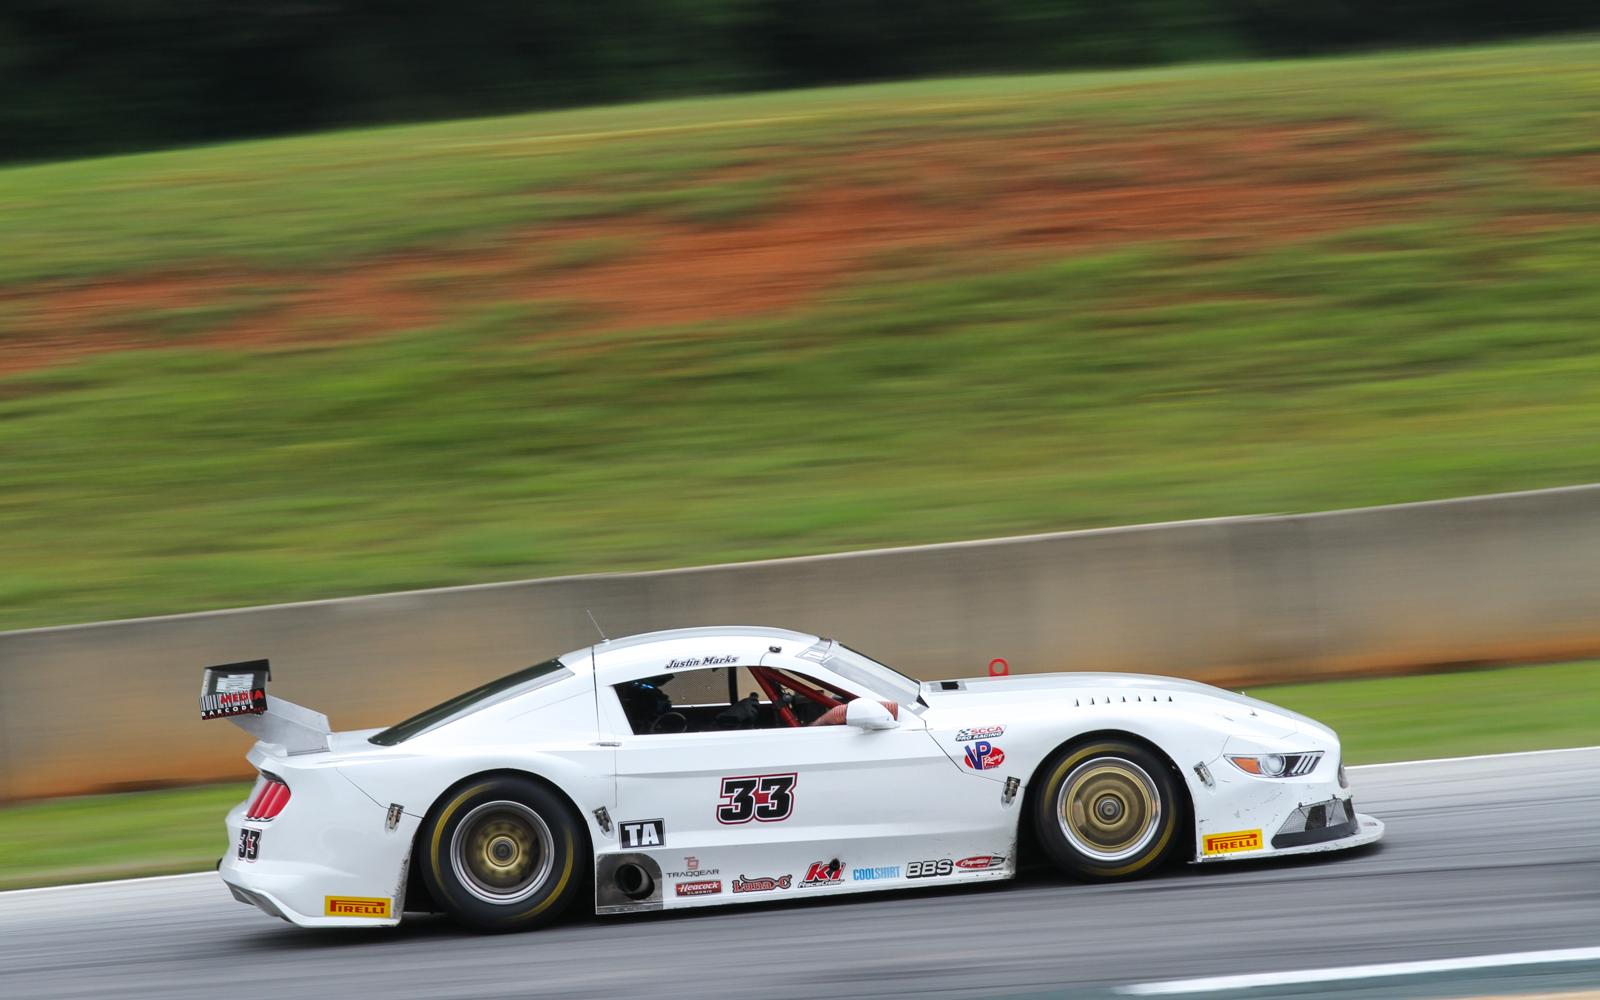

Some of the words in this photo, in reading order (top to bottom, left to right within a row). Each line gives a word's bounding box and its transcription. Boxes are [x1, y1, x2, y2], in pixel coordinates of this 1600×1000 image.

[665, 659, 699, 669] Justin
[702, 655, 739, 665] Marks
[219, 689, 264, 704] MEDIA
[201, 704, 254, 716] BARCODE
[970, 726, 1003, 735] SCCA
[964, 741, 992, 770] VP
[716, 773, 798, 825] 33
[625, 822, 660, 847] TA
[1207, 833, 1258, 851] PIRELLI
[238, 827, 262, 863] 33
[853, 866, 900, 880] COOLSHIRT
[905, 859, 955, 879] BBS
[329, 899, 386, 915] PIRELLI
